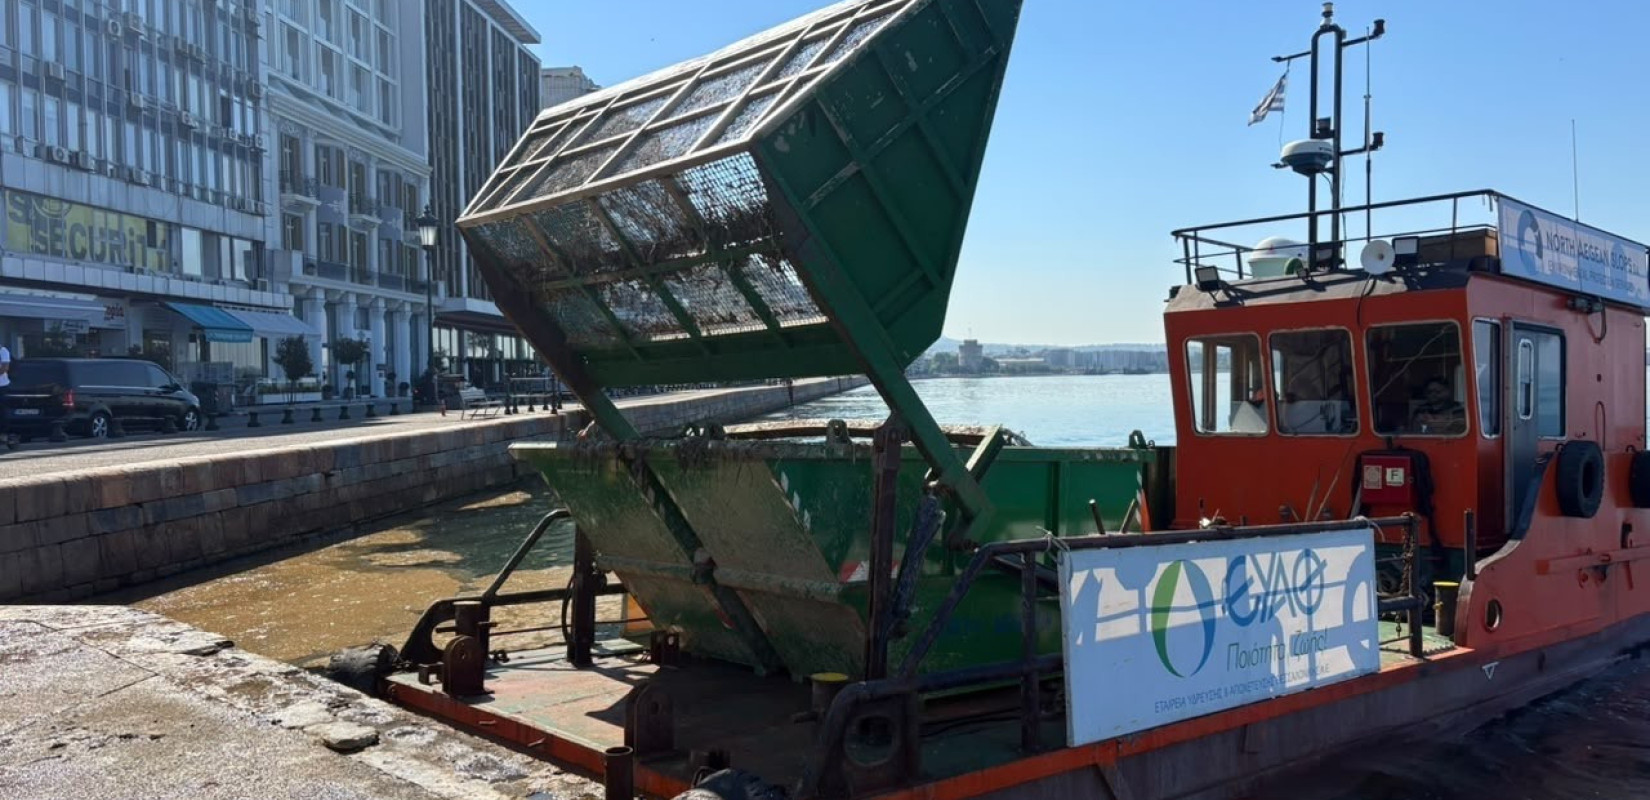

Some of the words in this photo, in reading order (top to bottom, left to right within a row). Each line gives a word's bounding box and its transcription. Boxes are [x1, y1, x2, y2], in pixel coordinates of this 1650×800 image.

[1546, 230, 1575, 257] NORTH
[1577, 240, 1609, 267] AEGEAN
[1390, 469, 1399, 480] F
[1227, 641, 1285, 672] Ποιότητα
[1293, 627, 1328, 661] ζωής!
[1154, 696, 1187, 714] ΕΤΑΙΡΕΙΑ
